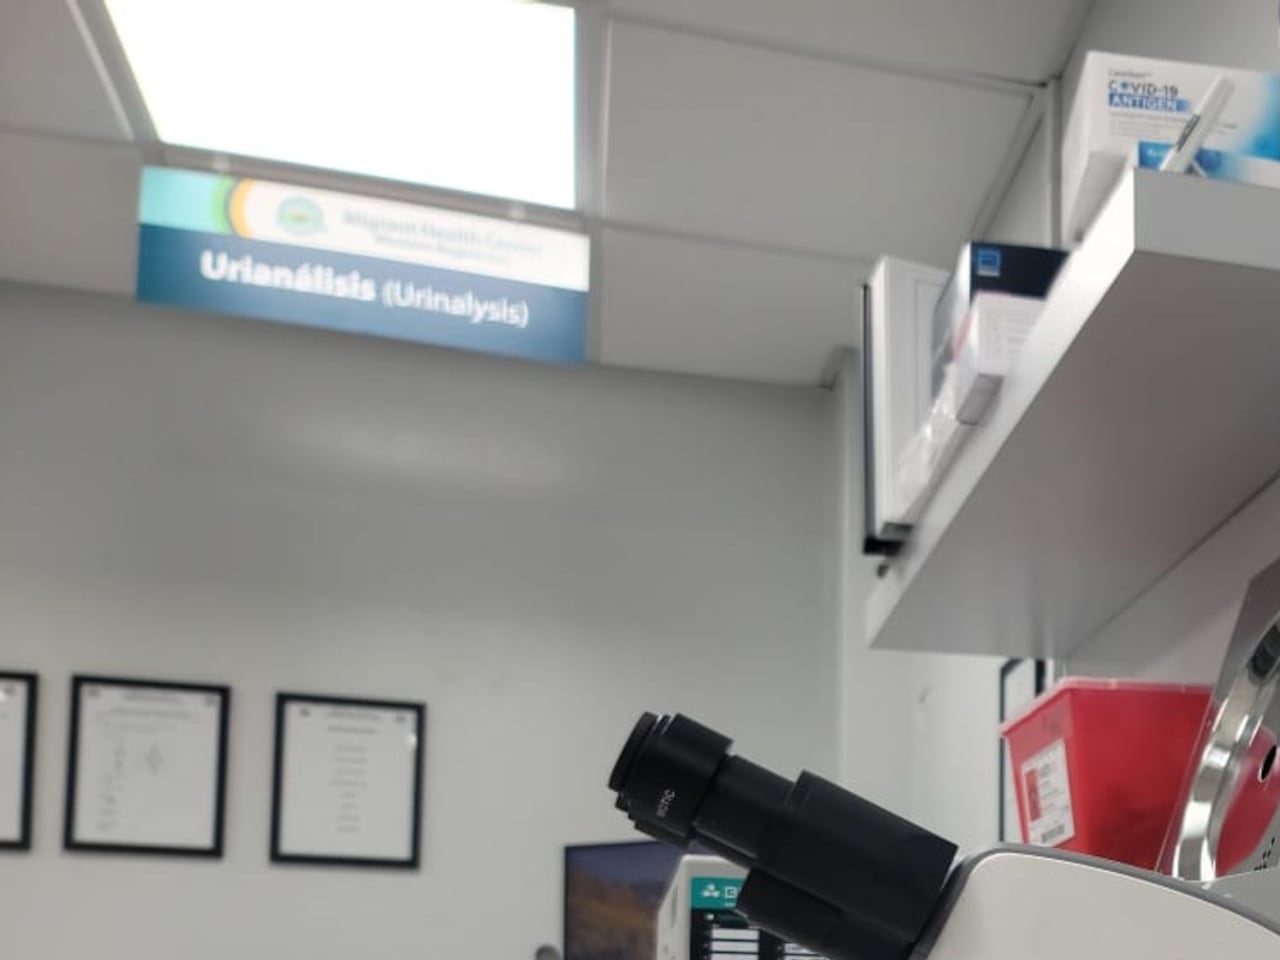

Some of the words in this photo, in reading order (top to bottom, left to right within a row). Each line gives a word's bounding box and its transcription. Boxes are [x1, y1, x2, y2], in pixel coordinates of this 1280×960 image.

[1110, 93, 1178, 113] ANTIGEN
[200, 250, 377, 301] Urianálisis
[382, 278, 530, 329] (Urinalysis)
